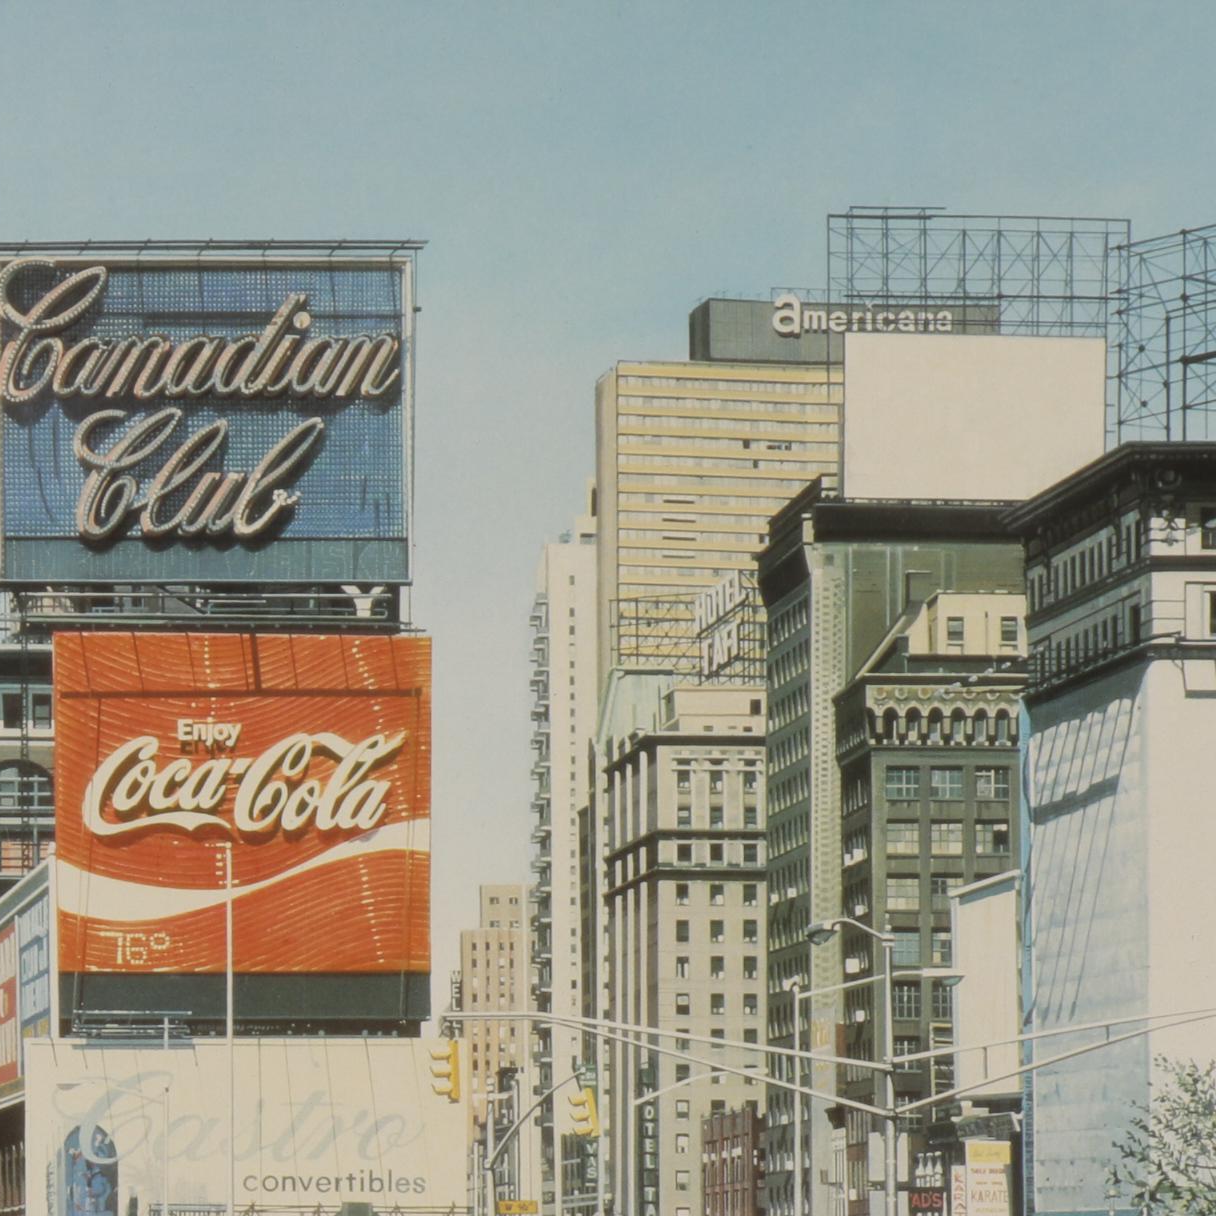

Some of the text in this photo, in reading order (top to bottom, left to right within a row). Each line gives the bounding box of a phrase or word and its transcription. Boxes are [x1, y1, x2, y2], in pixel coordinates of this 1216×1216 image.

[772, 293, 953, 336] americana
[73, 407, 325, 541] Club
[177, 718, 242, 747] Enjoy
[82, 731, 408, 836] Coca-Cola
[53, 1070, 425, 1164] Castro
[242, 1168, 427, 1194] convertibles
[910, 1192, 943, 1208] AD'S
